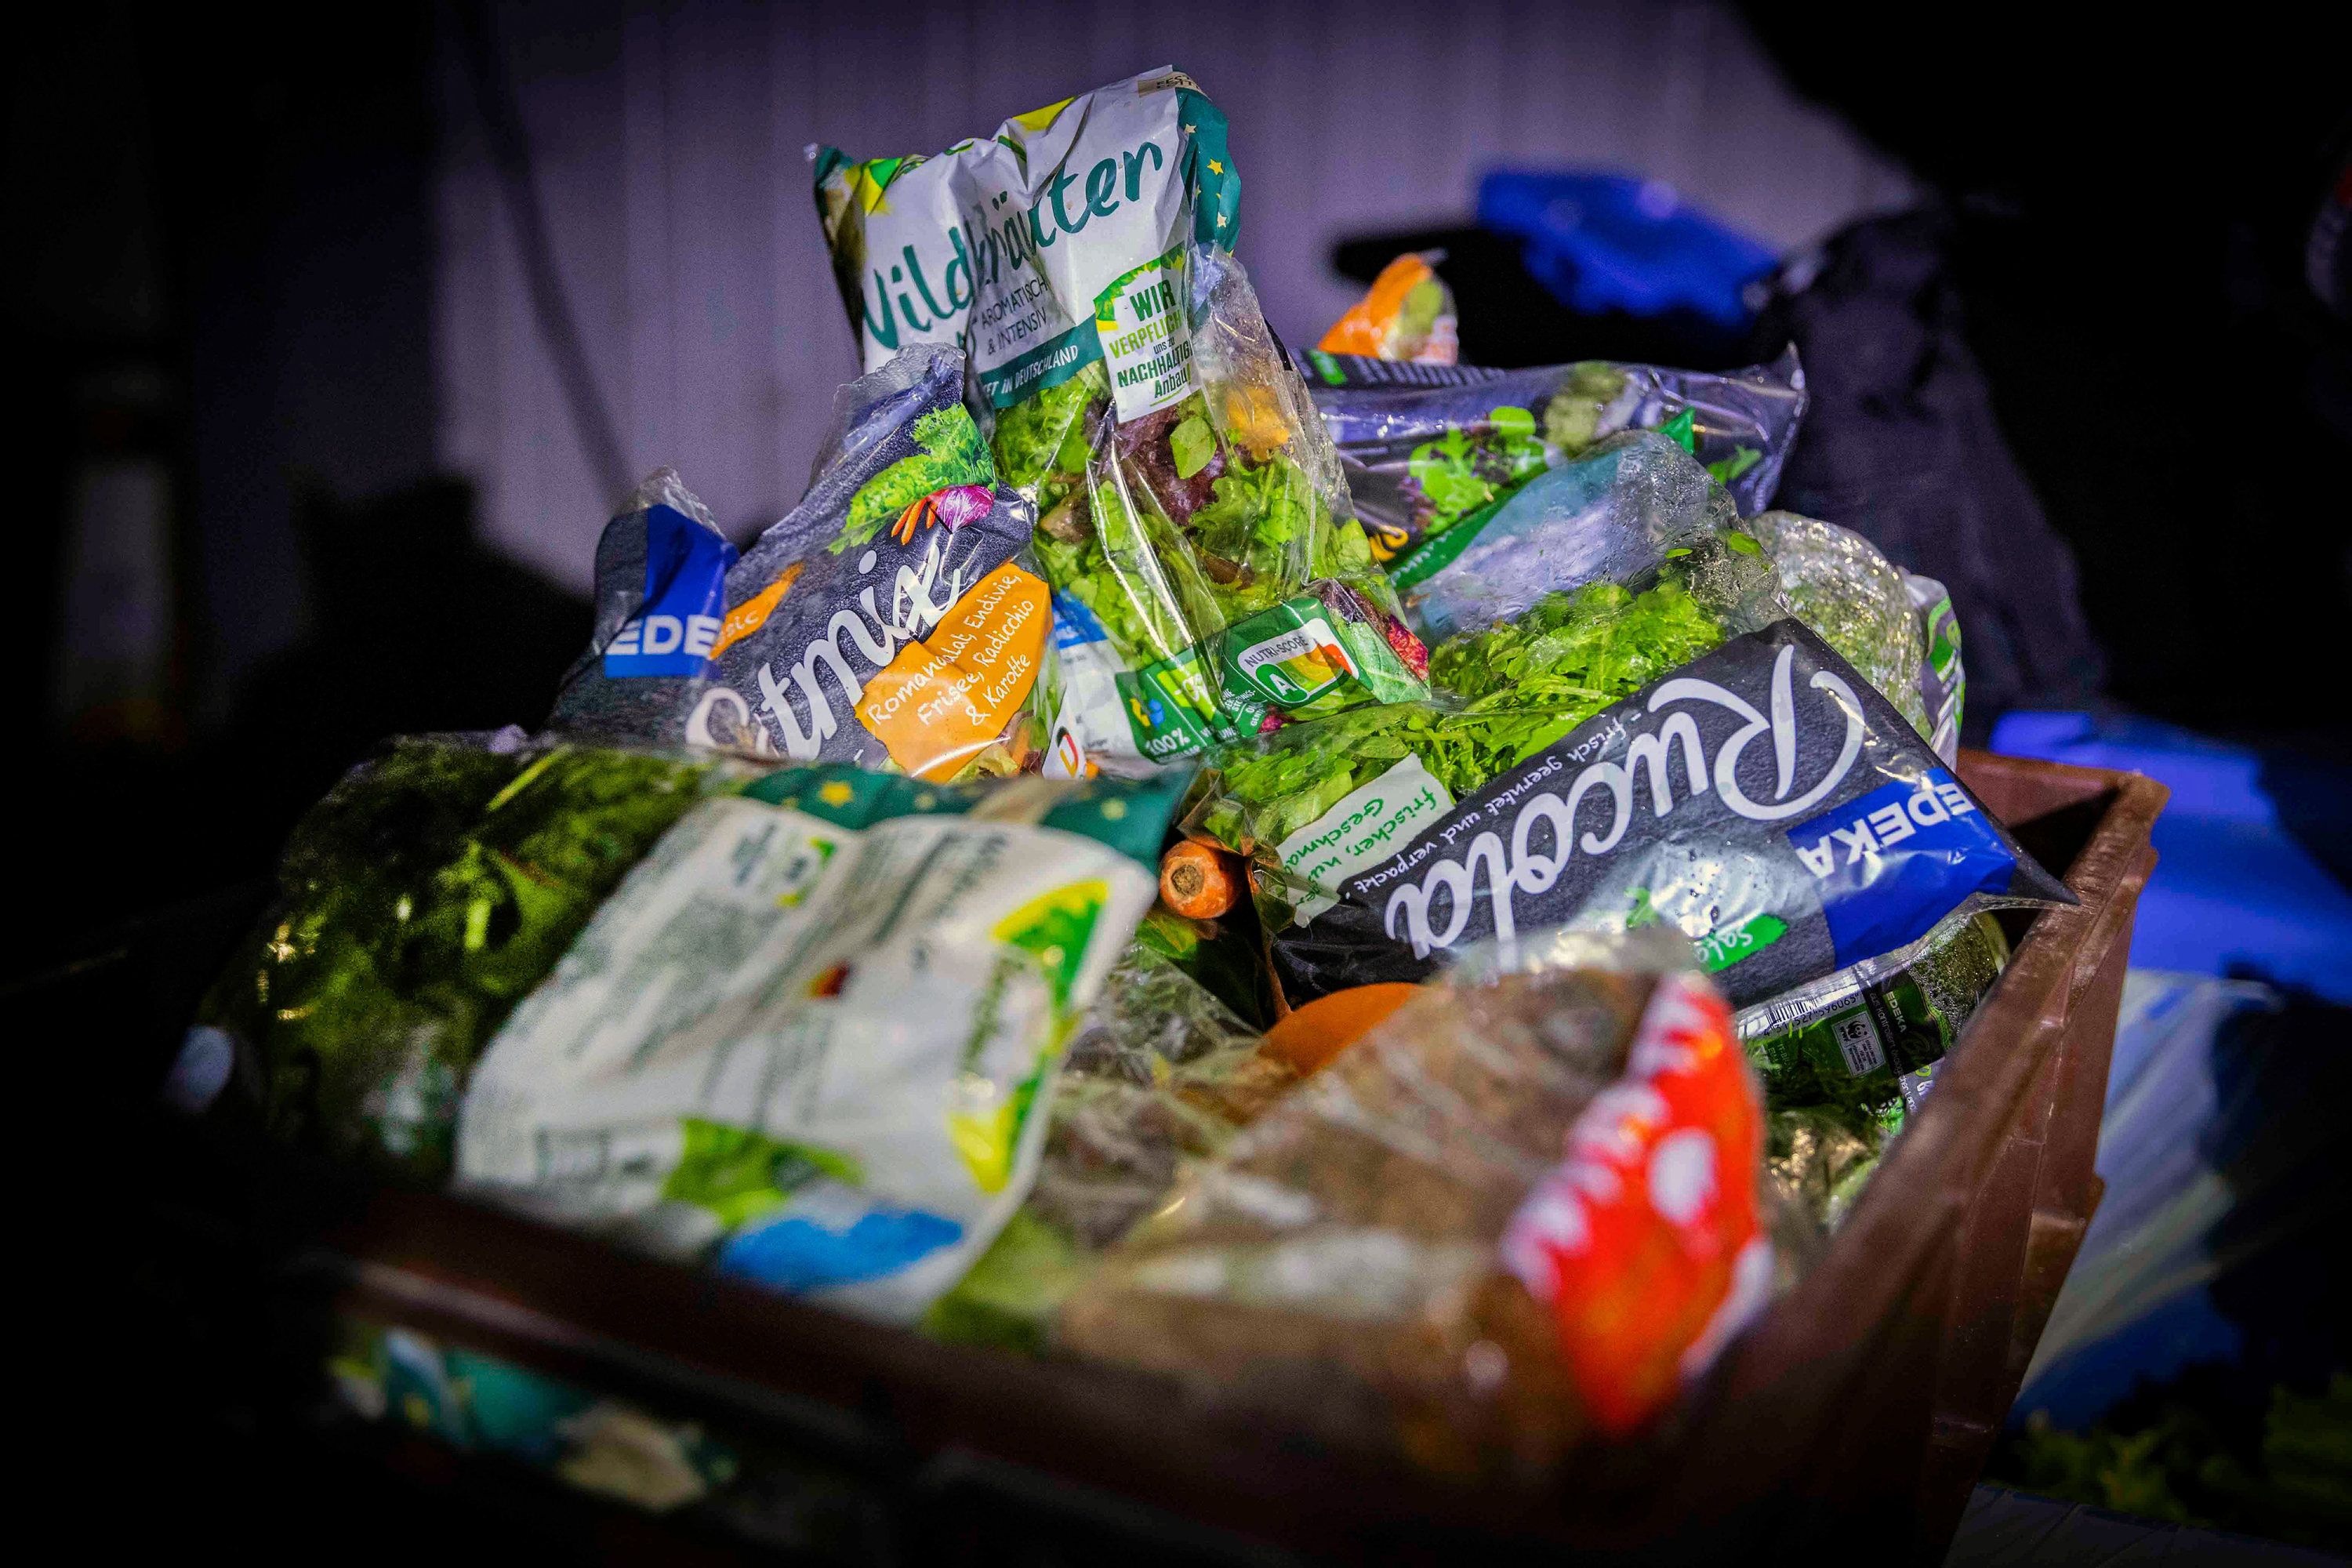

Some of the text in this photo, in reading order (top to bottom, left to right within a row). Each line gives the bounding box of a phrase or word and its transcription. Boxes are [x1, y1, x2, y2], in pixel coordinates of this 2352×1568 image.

[982, 275, 1047, 329] AROMATISCH
[1130, 279, 1175, 321] WIR
[988, 307, 1047, 355] & INTENSIV
[1153, 343, 1167, 354] uns
[1015, 345, 1079, 389] DEUTSCHLAND
[1154, 363, 1192, 399] Anbau!
[964, 575, 1022, 630] Endivie,
[917, 600, 1035, 726] Frisee, Radicchio
[1244, 636, 1309, 666] NUTRI-SCORE
[966, 654, 1031, 726] & Karotte
[1269, 673, 1298, 696] A
[1145, 728, 1191, 755] 100%
[1567, 717, 1627, 764] frisch
[1385, 644, 1866, 972] Rucola
[1483, 756, 1563, 816] geerntet
[1345, 786, 1437, 857] frischer,
[1439, 811, 1481, 846] und
[1795, 782, 1976, 880] EDEKA
[1353, 841, 1438, 894] verpackt
[1886, 990, 1907, 1034] EDEKA
